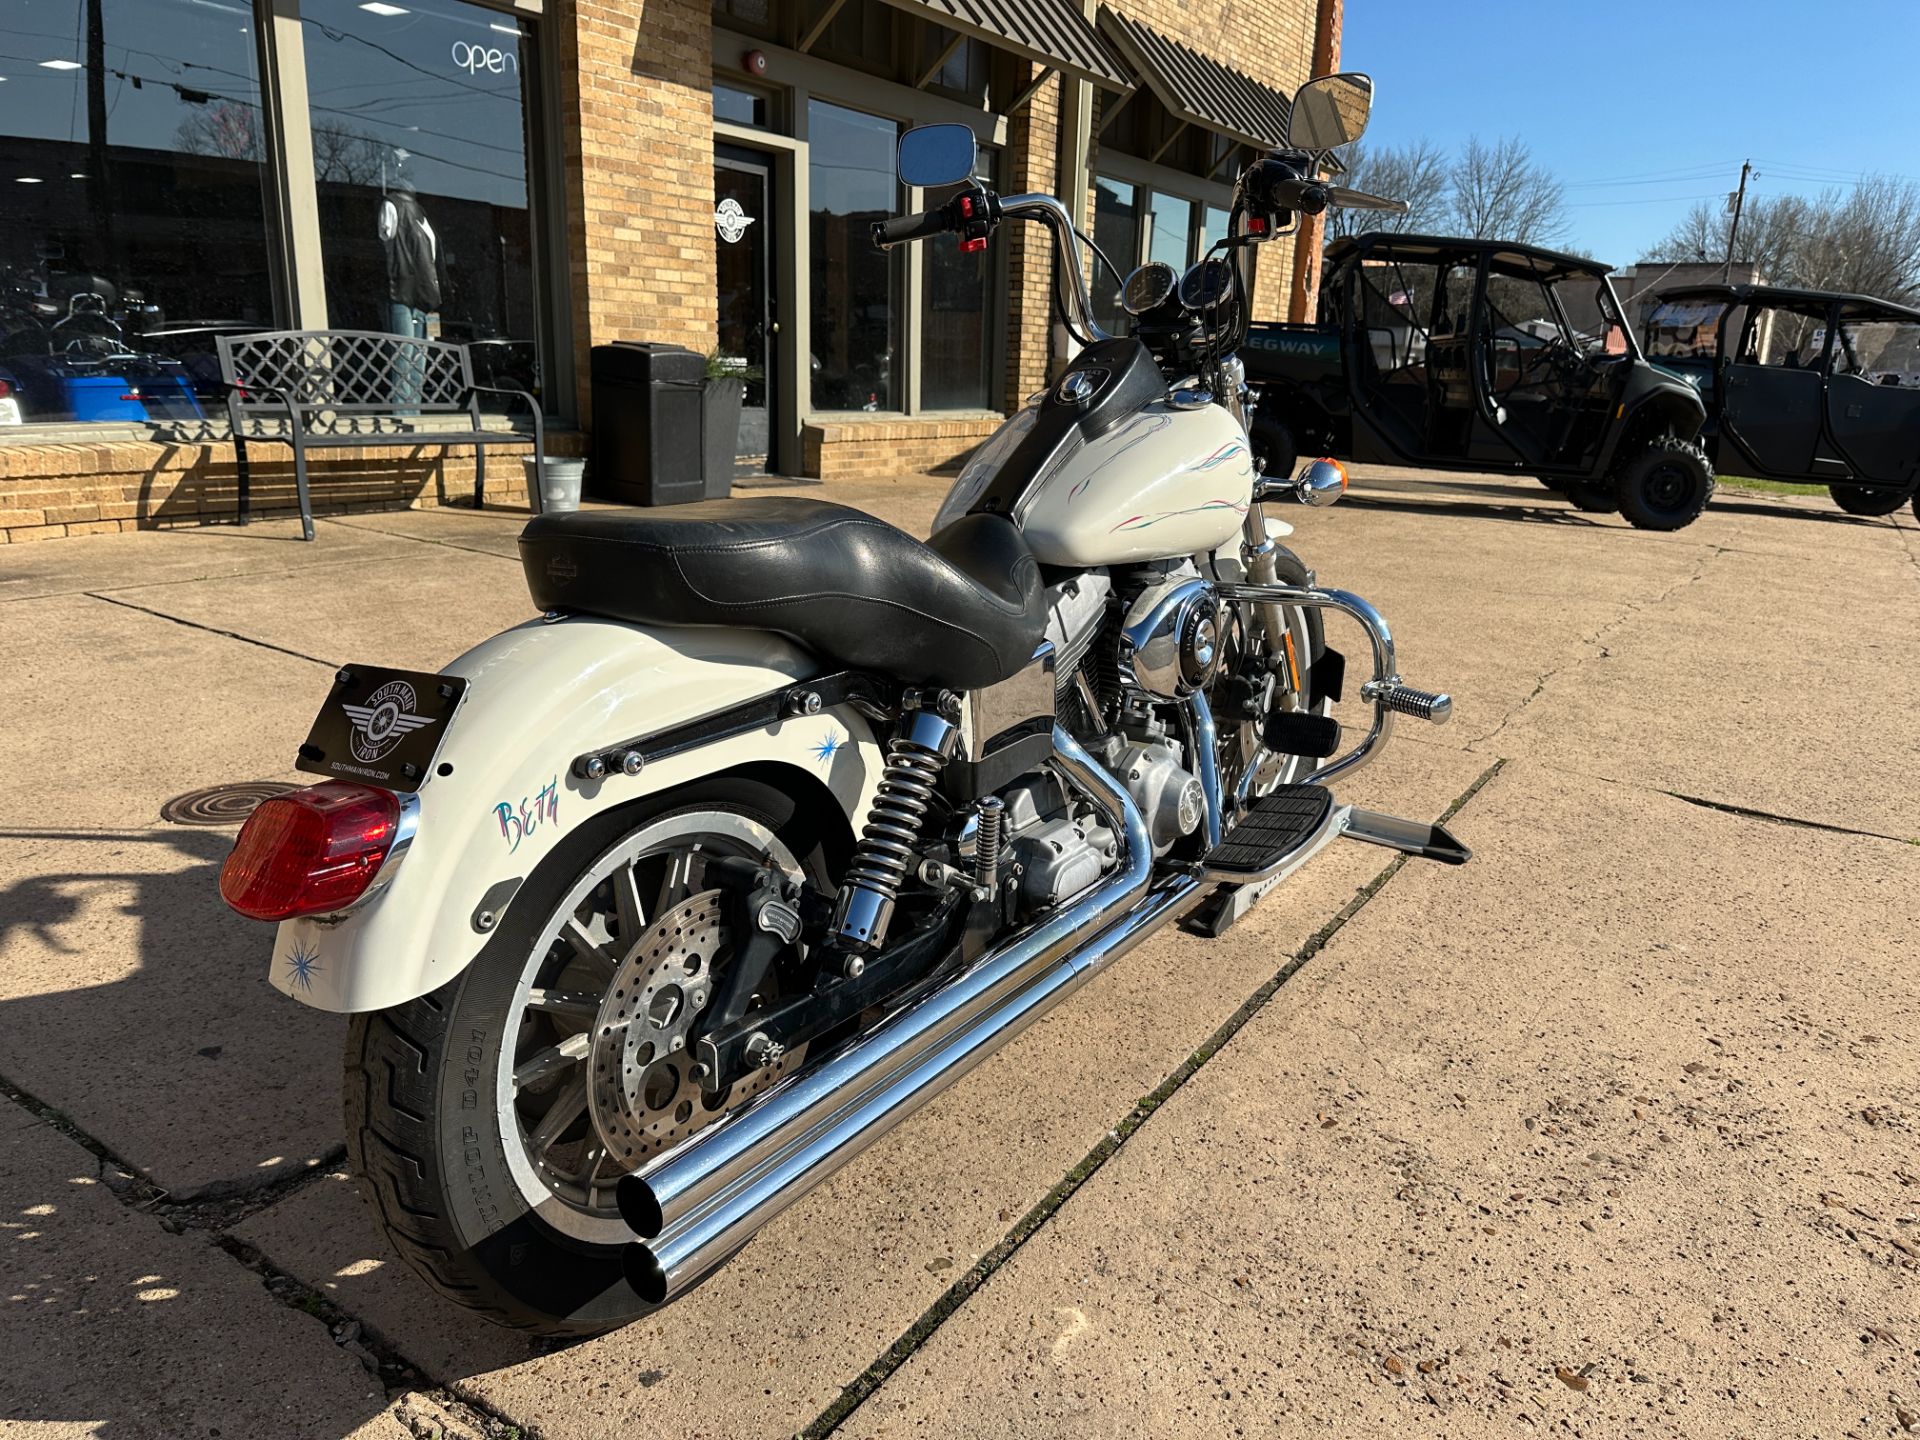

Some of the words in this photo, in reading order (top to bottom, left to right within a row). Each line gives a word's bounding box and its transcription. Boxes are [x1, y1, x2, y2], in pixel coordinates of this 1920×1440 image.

[371, 684, 400, 705] SOUTH
[400, 684, 415, 710] MAIN
[357, 746, 377, 760] IRON
[330, 761, 390, 780] SOUTHMAINIRON.COM
[462, 1029, 487, 1110] D401
